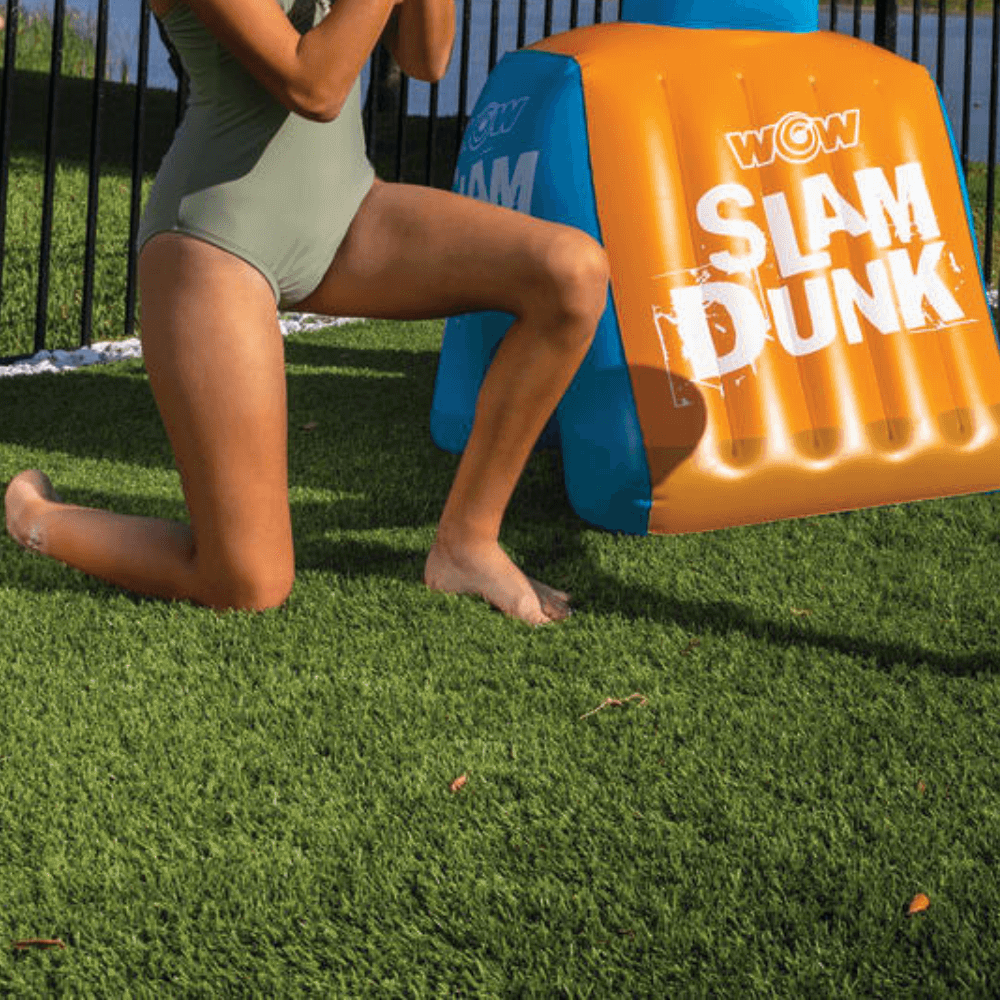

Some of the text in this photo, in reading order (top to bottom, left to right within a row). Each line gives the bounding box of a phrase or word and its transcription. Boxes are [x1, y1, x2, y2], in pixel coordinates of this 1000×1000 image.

[460, 96, 530, 151] OW
[725, 109, 860, 170] WOW
[453, 150, 540, 214] AM
[696, 161, 941, 279] SLAM
[669, 241, 966, 381] DUNK
